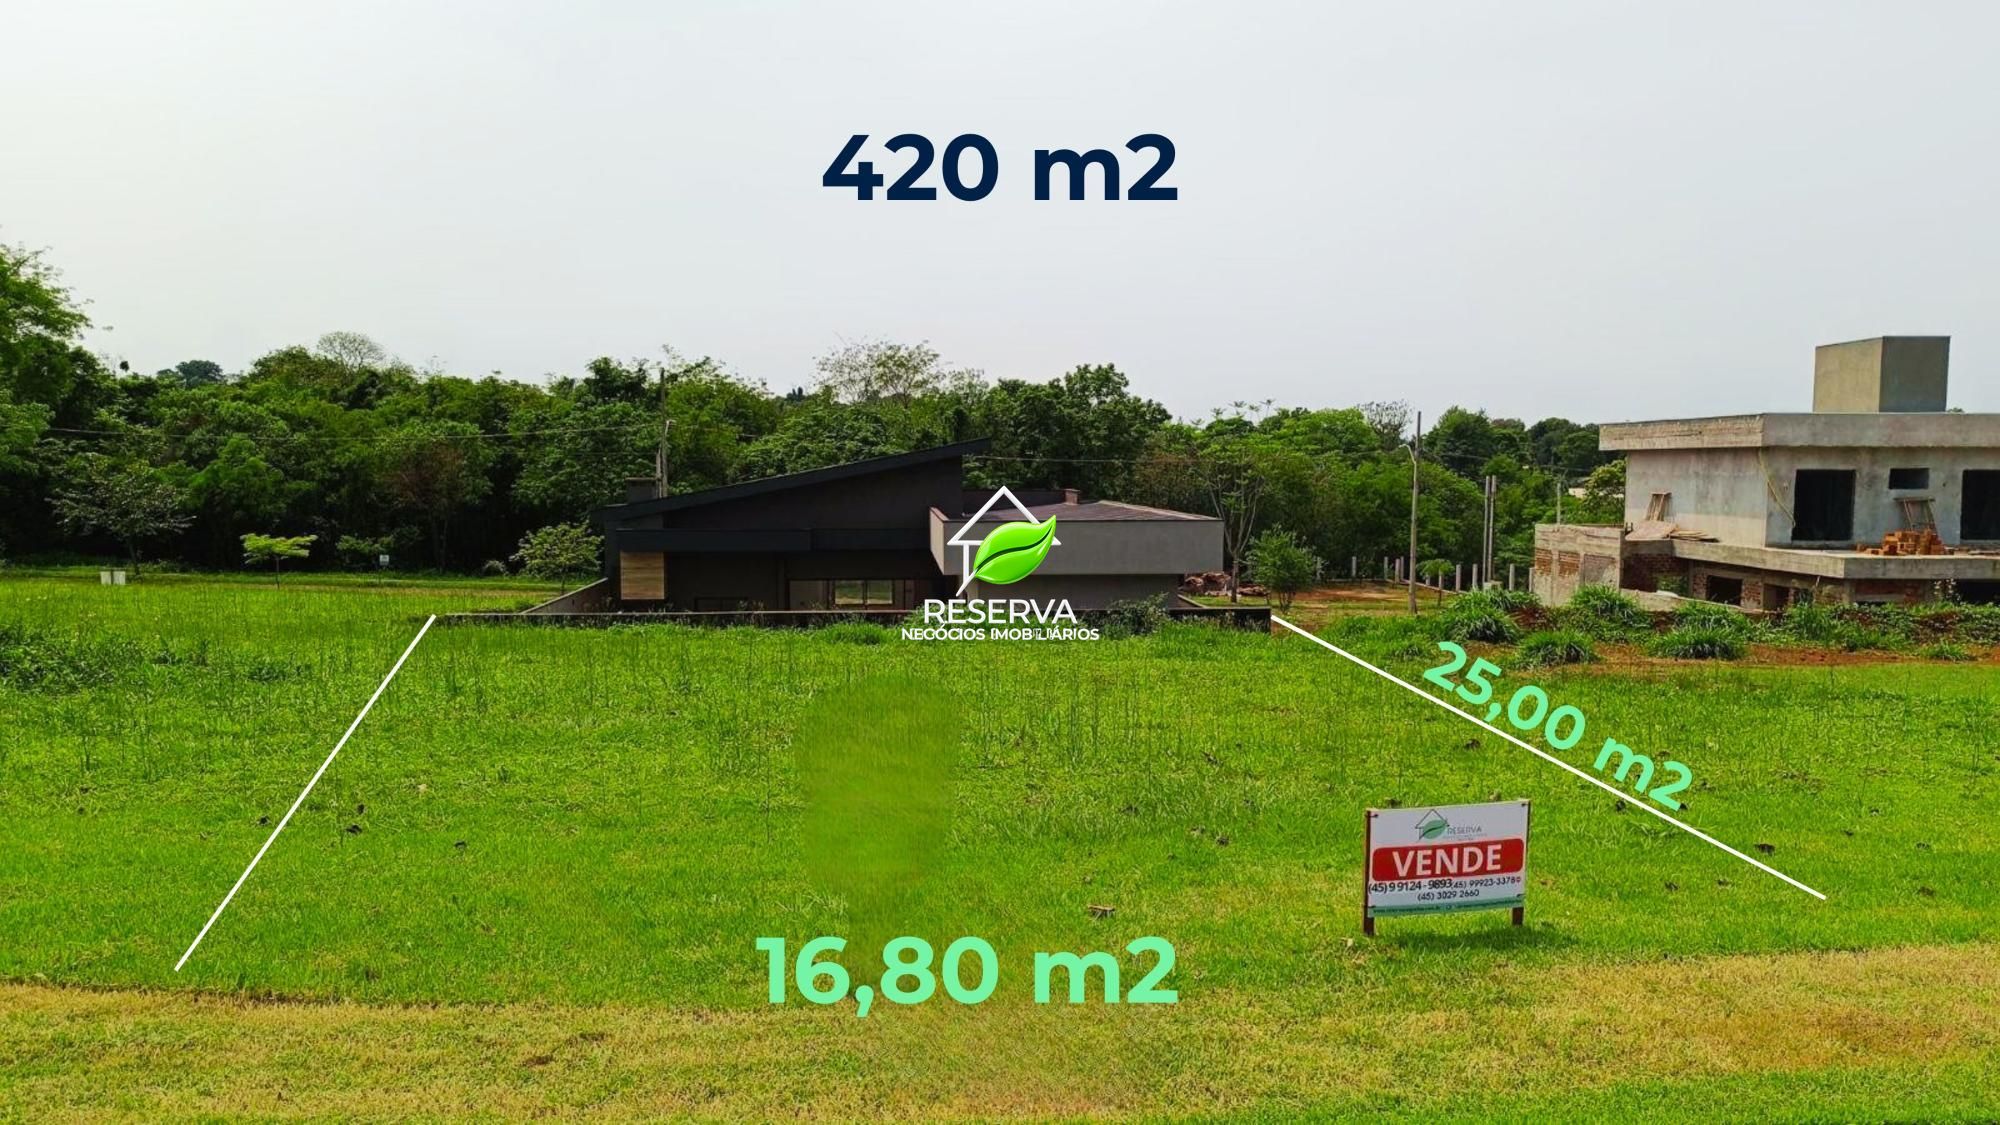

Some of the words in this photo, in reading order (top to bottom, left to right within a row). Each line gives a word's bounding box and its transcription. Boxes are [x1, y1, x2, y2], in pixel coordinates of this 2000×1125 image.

[1392, 844, 1503, 877] VENDE
[1417, 891, 1435, 901] (45)
[1436, 890, 1457, 900] 3029
[1459, 889, 1480, 898] 2660
